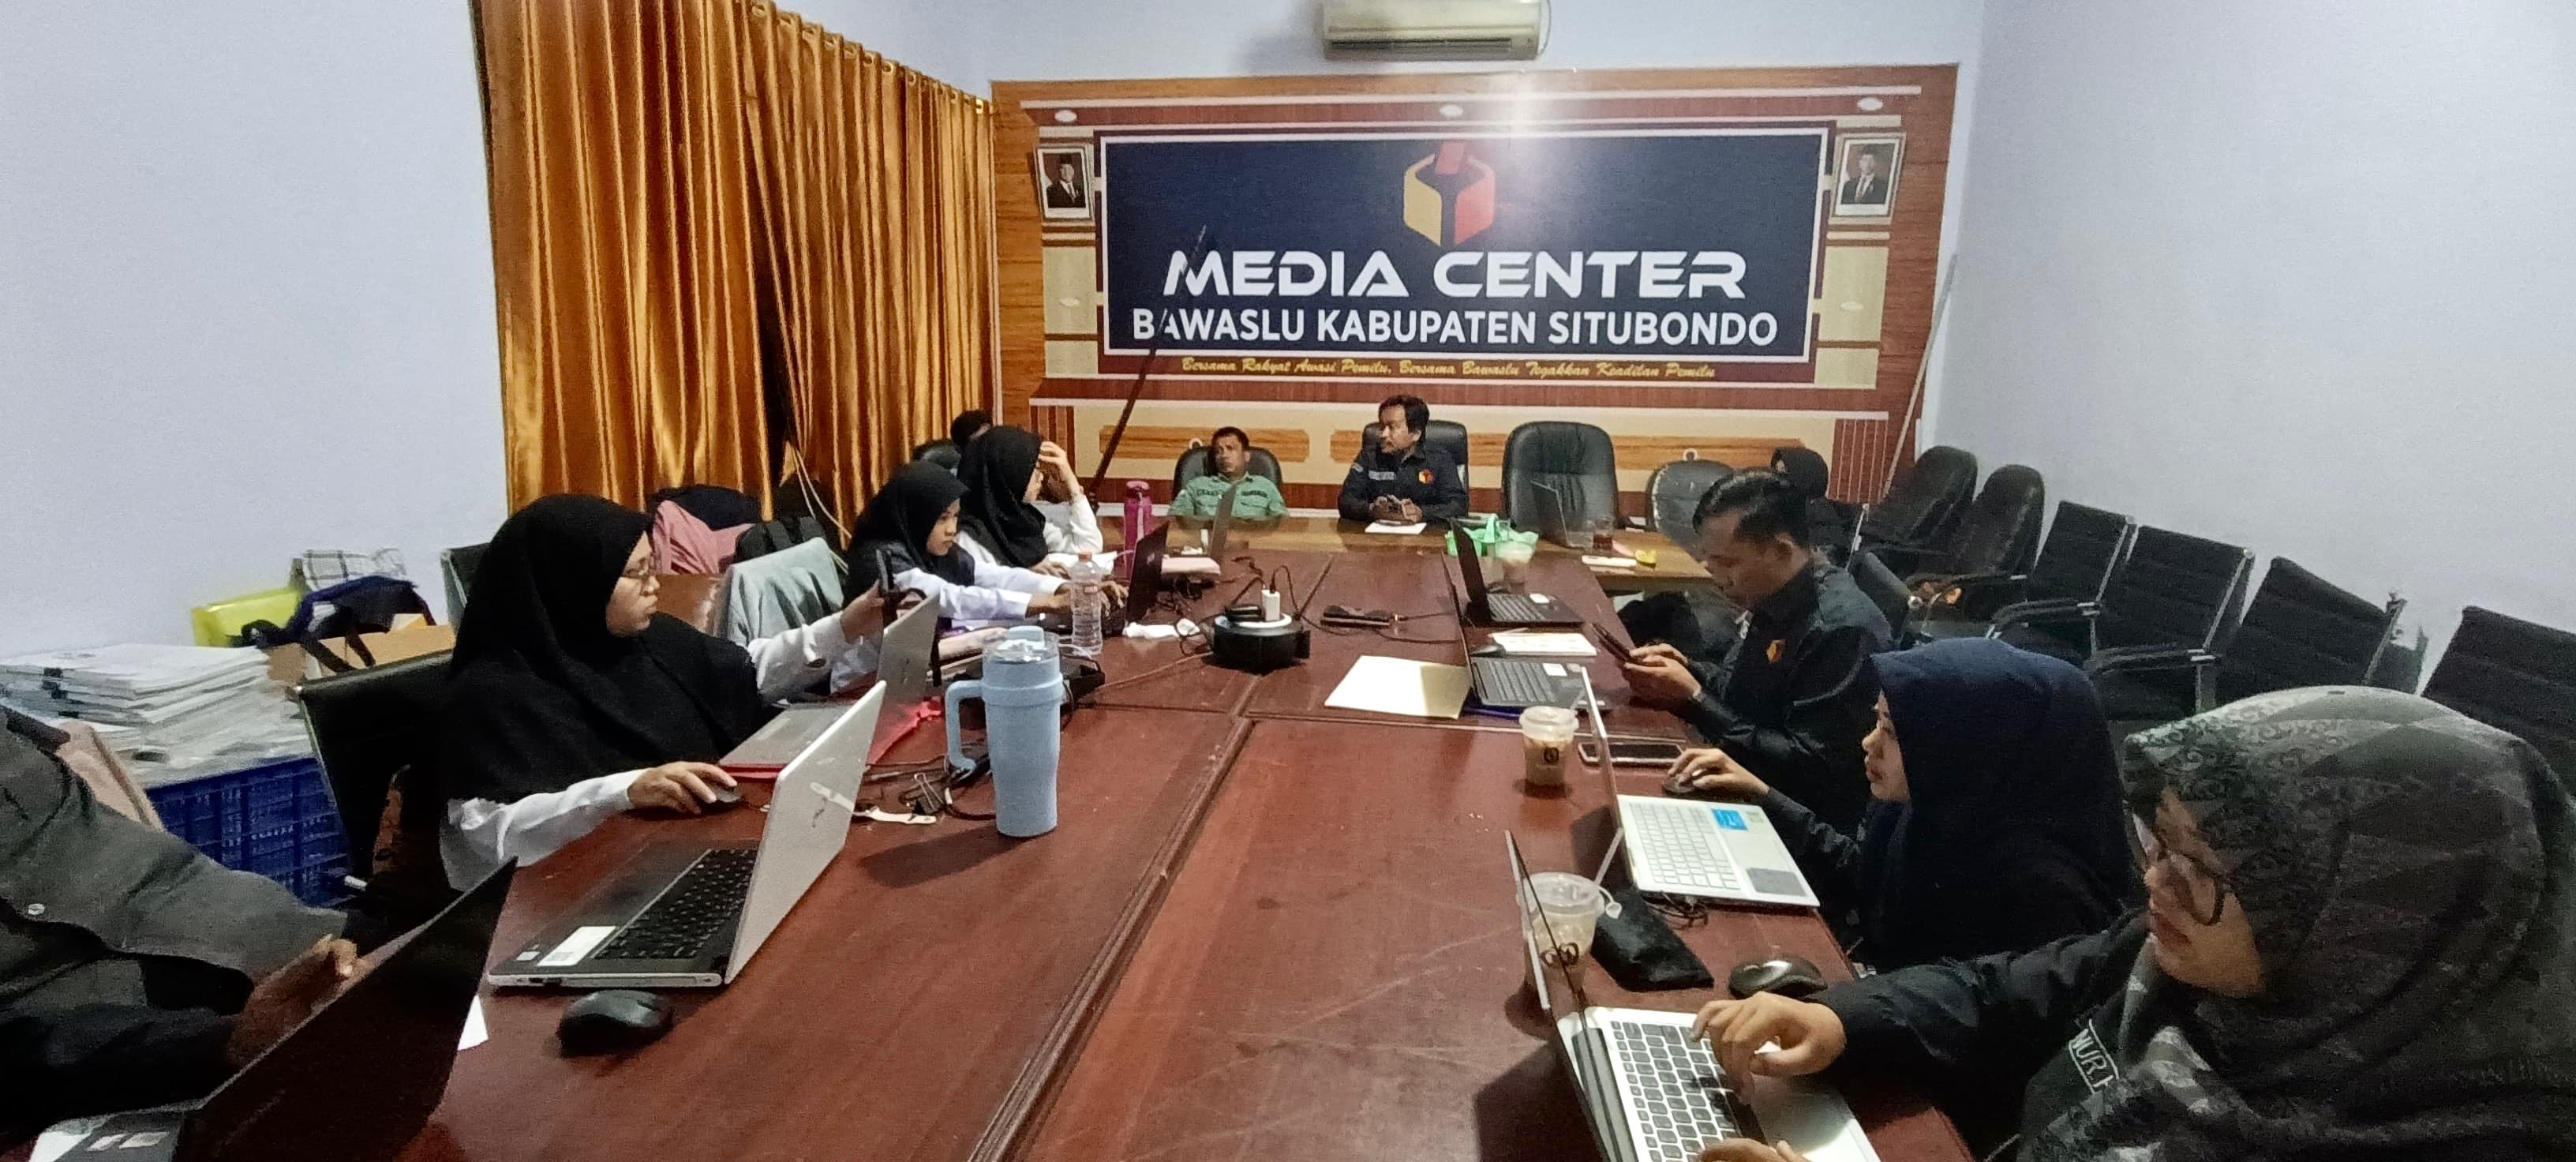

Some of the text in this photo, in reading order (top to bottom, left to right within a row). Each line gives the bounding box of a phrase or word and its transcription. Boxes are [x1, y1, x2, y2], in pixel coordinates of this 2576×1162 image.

[1163, 250, 1747, 298] MEDIA CENTER
[1133, 308, 1777, 346] BAWASLU KABUPATEN SITUBONDO
[1181, 357, 1237, 371] Bersama
[1241, 358, 1291, 374] Rakyat
[1294, 358, 1336, 373] Awasi
[1341, 358, 1391, 373] Pemilu,
[1398, 359, 1455, 374] Bersama
[1462, 360, 1519, 375] Bawaslu
[1596, 362, 1659, 377] Keadilan
[1664, 362, 1715, 377] Pemilu
[2072, 1032, 2107, 1075] NUR
